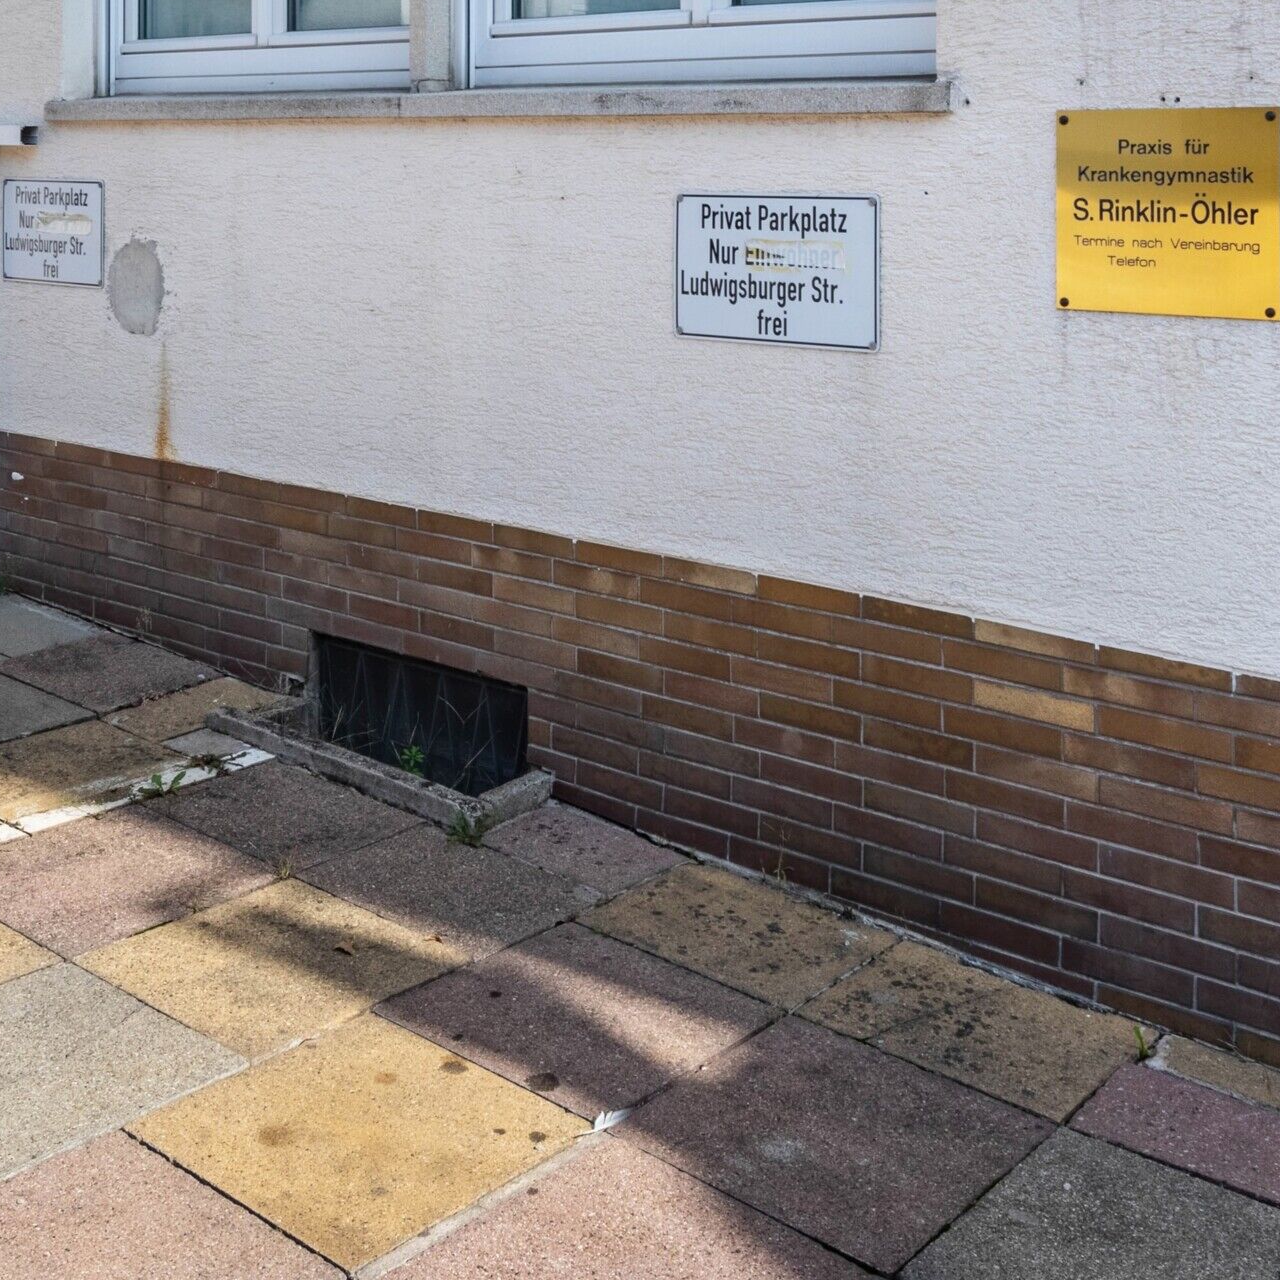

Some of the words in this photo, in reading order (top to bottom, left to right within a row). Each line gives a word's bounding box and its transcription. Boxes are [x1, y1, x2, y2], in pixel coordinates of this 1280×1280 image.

[1118, 139, 1172, 155] Praxis
[1184, 139, 1210, 155] für
[1077, 166, 1254, 186] Krankengymnastik
[15, 186, 41, 204] Privat
[43, 186, 88, 210] Parkplatz
[19, 210, 34, 228] Nur
[701, 203, 751, 230] Privat
[758, 204, 847, 239] Parkplatz
[5, 232, 67, 258] Ludwigsburger
[70, 236, 86, 256] Str.
[709, 238, 738, 265] Nur
[1073, 234, 1124, 248] Termine
[1132, 238, 1162, 249] nach
[1170, 238, 1261, 254] Vereinbarung
[43, 260, 58, 278] frei
[1107, 255, 1156, 268] Telefon
[681, 270, 805, 308] Ludwigsburger
[811, 276, 843, 304] Str.
[757, 309, 787, 336] frei
